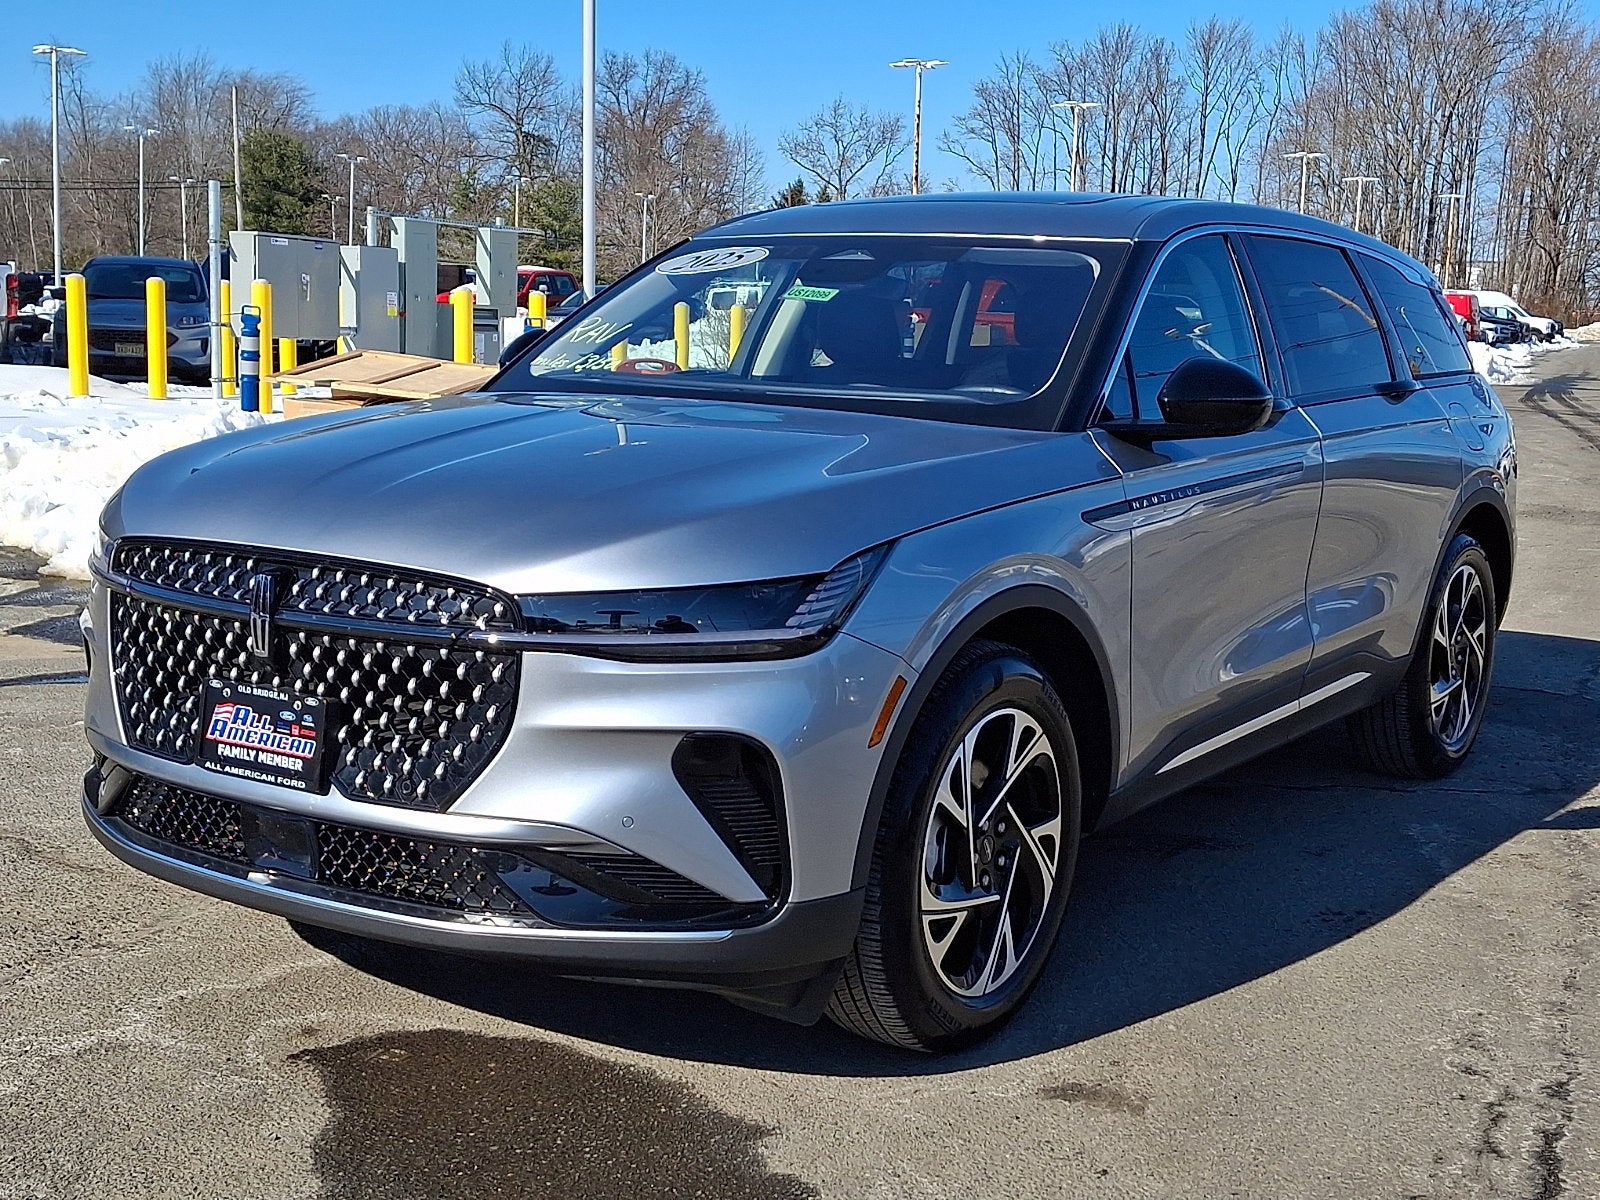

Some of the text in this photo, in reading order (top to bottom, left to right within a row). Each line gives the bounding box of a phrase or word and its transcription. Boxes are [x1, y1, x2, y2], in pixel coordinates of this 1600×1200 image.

[671, 249, 755, 271] 2025
[788, 287, 832, 300] US12099
[1132, 486, 1201, 510] NAUTILUS
[237, 684, 252, 695] OLD
[217, 743, 303, 772] FAMILY MEMBER
[204, 761, 306, 789] ALL AMERICAN FORD
